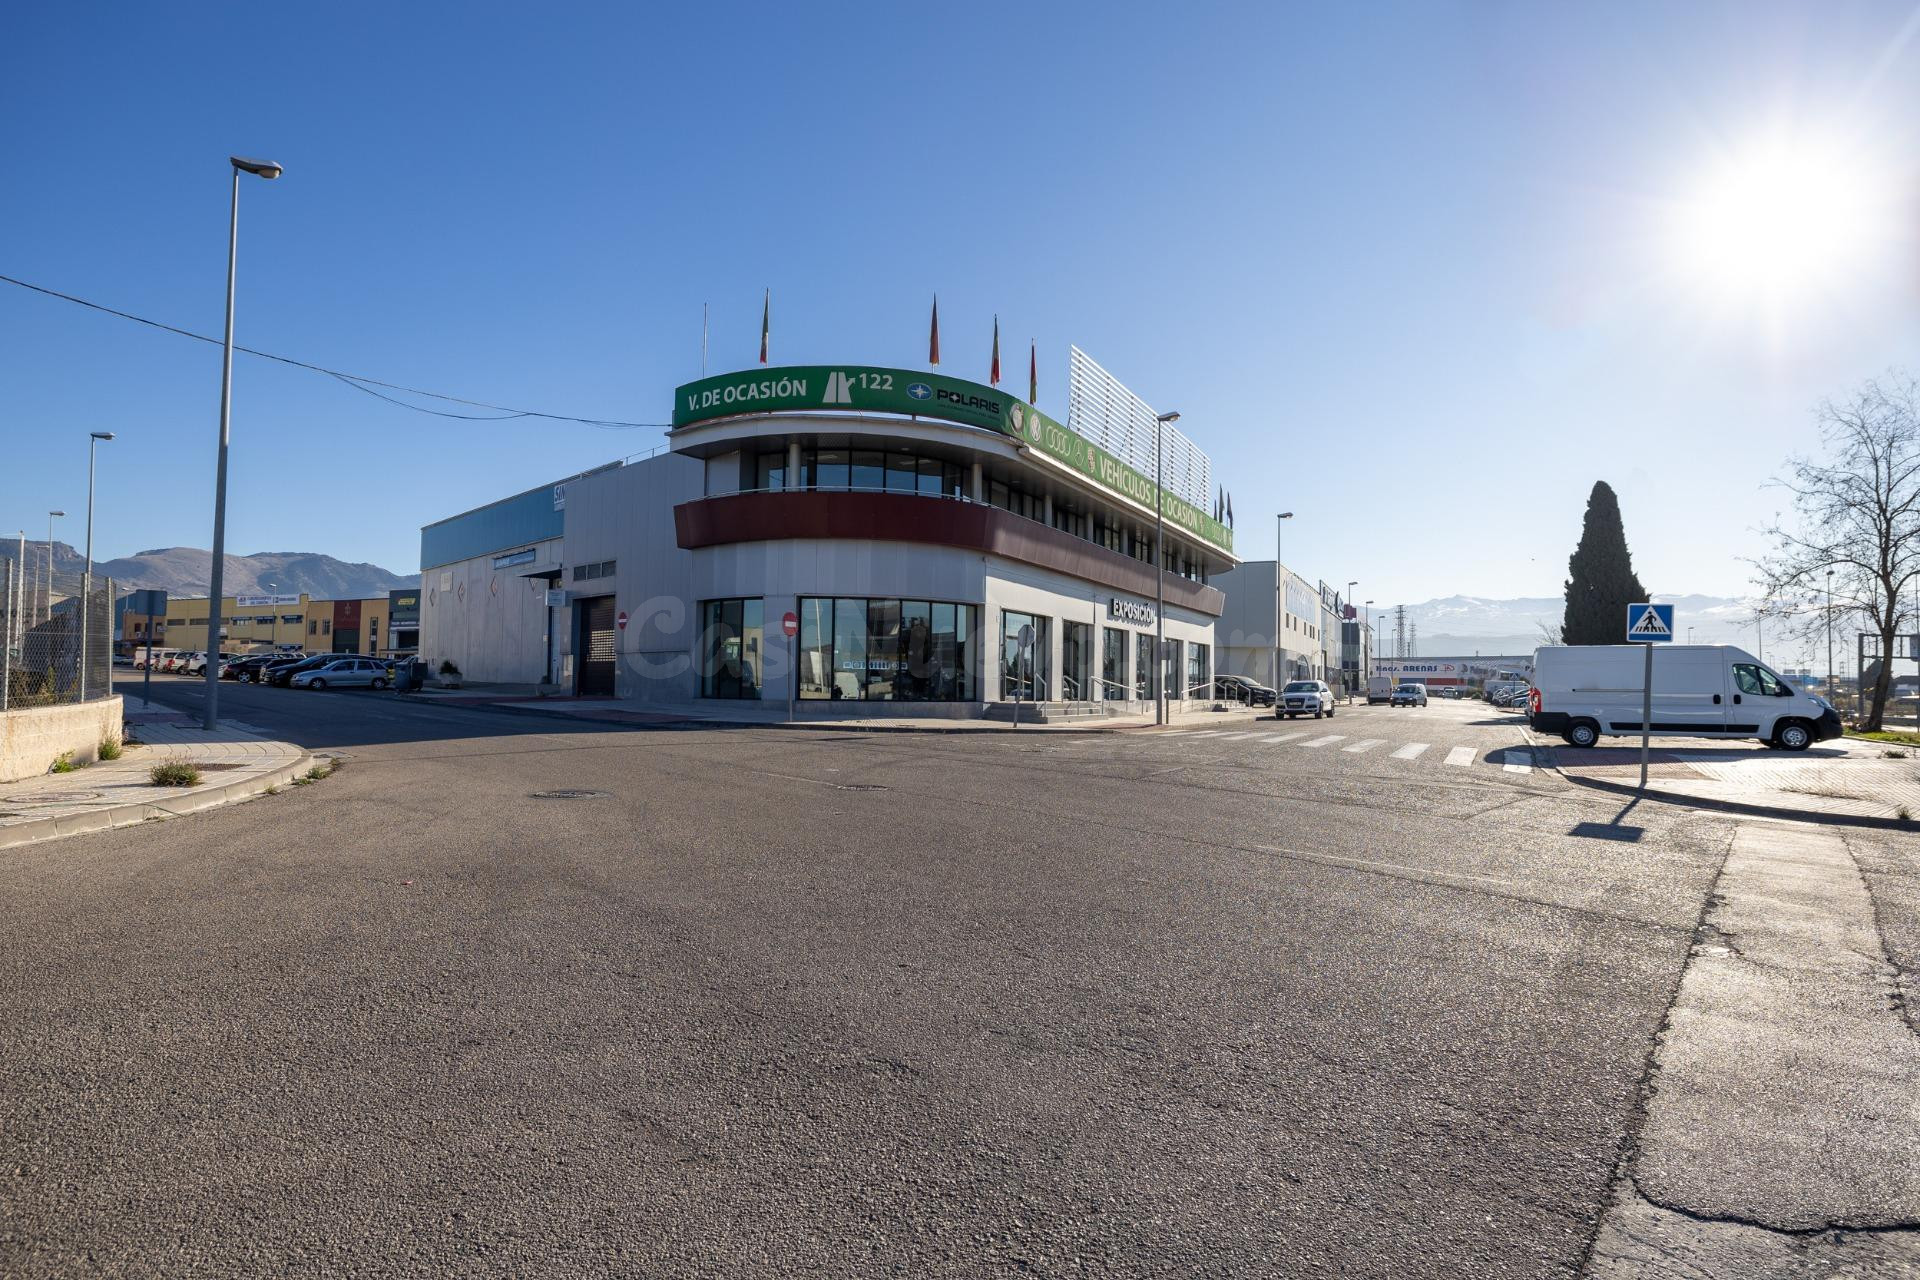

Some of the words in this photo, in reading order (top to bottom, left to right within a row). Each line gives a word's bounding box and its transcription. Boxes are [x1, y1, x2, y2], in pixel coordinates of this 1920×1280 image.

[688, 394, 699, 411] V.
[702, 388, 721, 408] DE
[723, 377, 807, 404] OCASIÓN
[859, 373, 893, 391] 122
[937, 388, 1000, 414] POLARIS
[1099, 455, 1151, 503] VEHÍCULOS
[1167, 497, 1198, 529] OCASIÓN
[1113, 598, 1156, 624] EXPOSICIÓN
